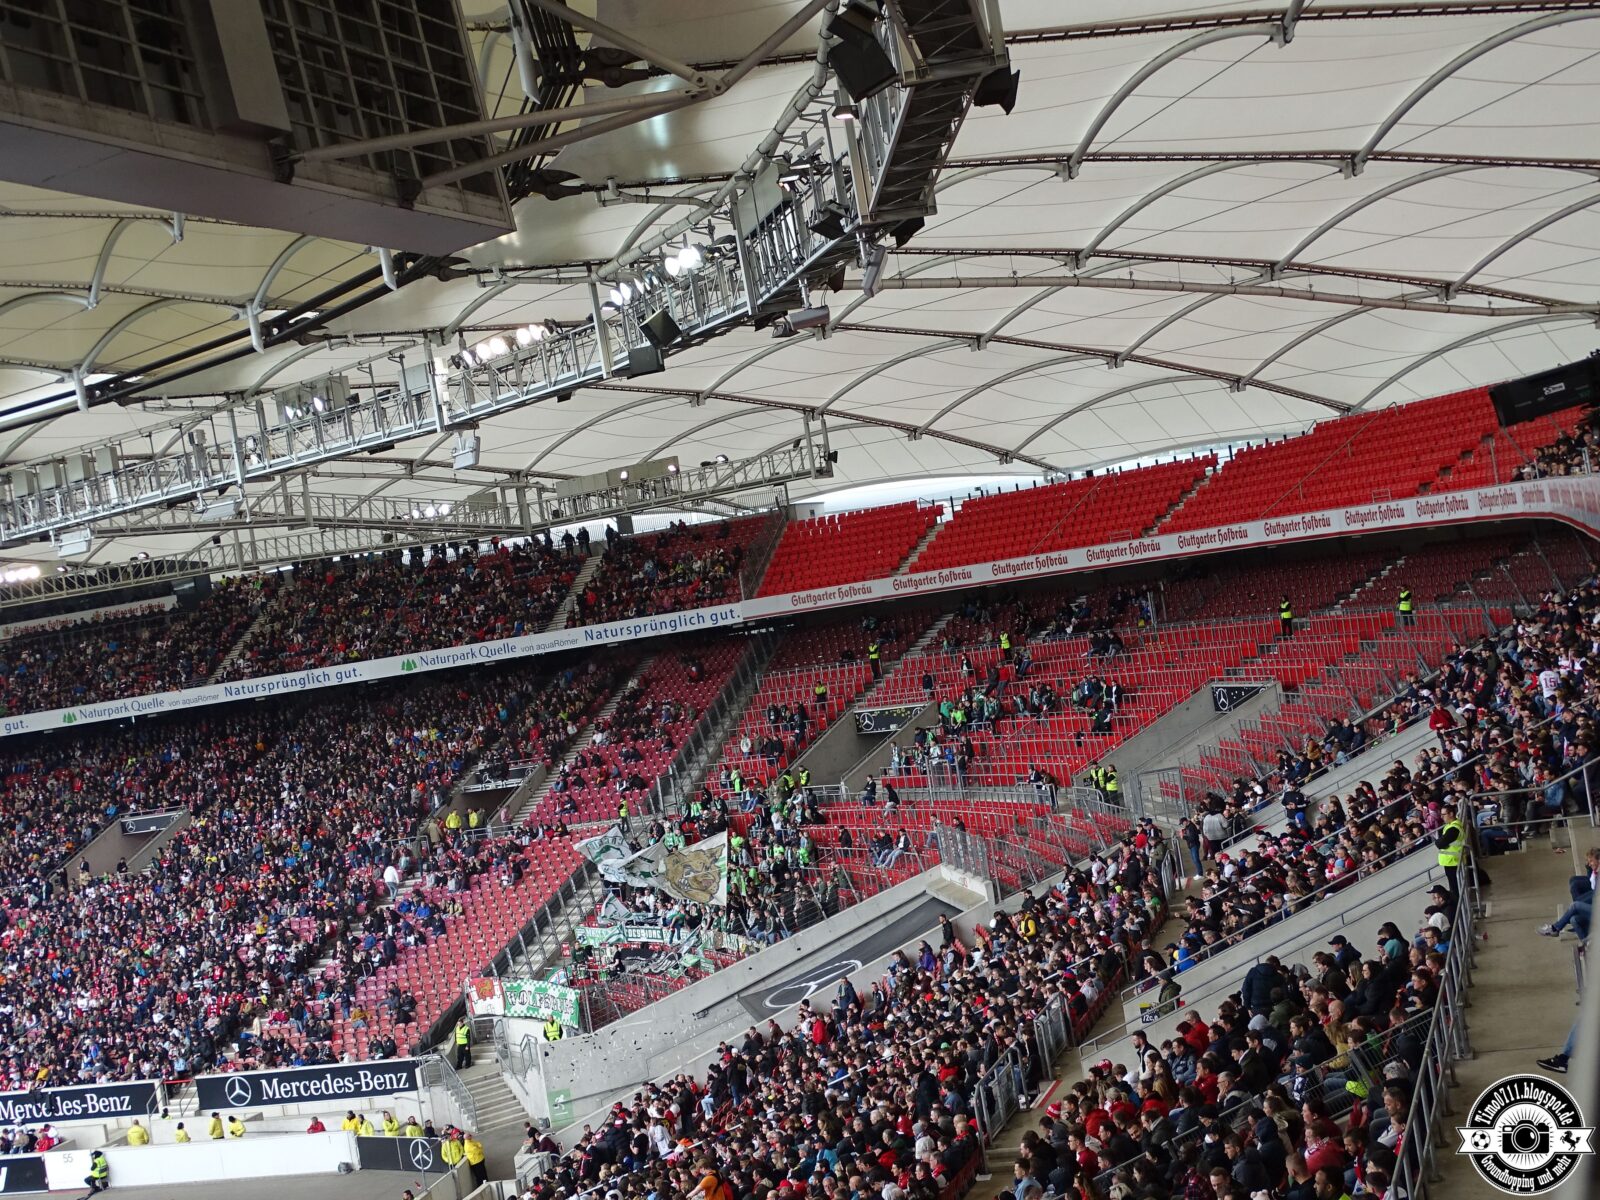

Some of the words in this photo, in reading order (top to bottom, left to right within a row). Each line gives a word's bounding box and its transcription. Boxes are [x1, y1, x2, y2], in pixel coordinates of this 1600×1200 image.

[1263, 519, 1301, 538] Stuttgarter
[1301, 513, 1331, 534] Hofbräu
[1344, 508, 1378, 527] Stuttgarter
[1378, 503, 1405, 523] Hofbräu
[1177, 532, 1217, 550] Stuttgarter
[1217, 526, 1248, 546] Hofbräu
[1085, 545, 1128, 562] Stuttgarter
[1128, 540, 1161, 557] Hofbräu
[991, 559, 1034, 577] Stuttgarter
[1035, 554, 1068, 571] Hofbräu
[892, 576, 938, 591] Stuttgarter
[938, 569, 972, 586] Hofbräu
[791, 591, 836, 606] Stuttgarter
[837, 584, 872, 600] Hofbräu
[420, 649, 478, 669] Naturpark
[478, 642, 517, 658] Quelle
[535, 638, 579, 652] aquaRömer
[584, 614, 706, 641] Natursprünglich
[710, 608, 741, 624] gut.
[4, 719, 29, 733] gut.
[79, 702, 130, 720] Naturpark
[131, 697, 165, 712] Quelle
[224, 671, 331, 697] Natursprünglich
[335, 668, 363, 682] gut.
[262, 1071, 409, 1101] Mercedes-Benz
[62, 1154, 74, 1164] 55
